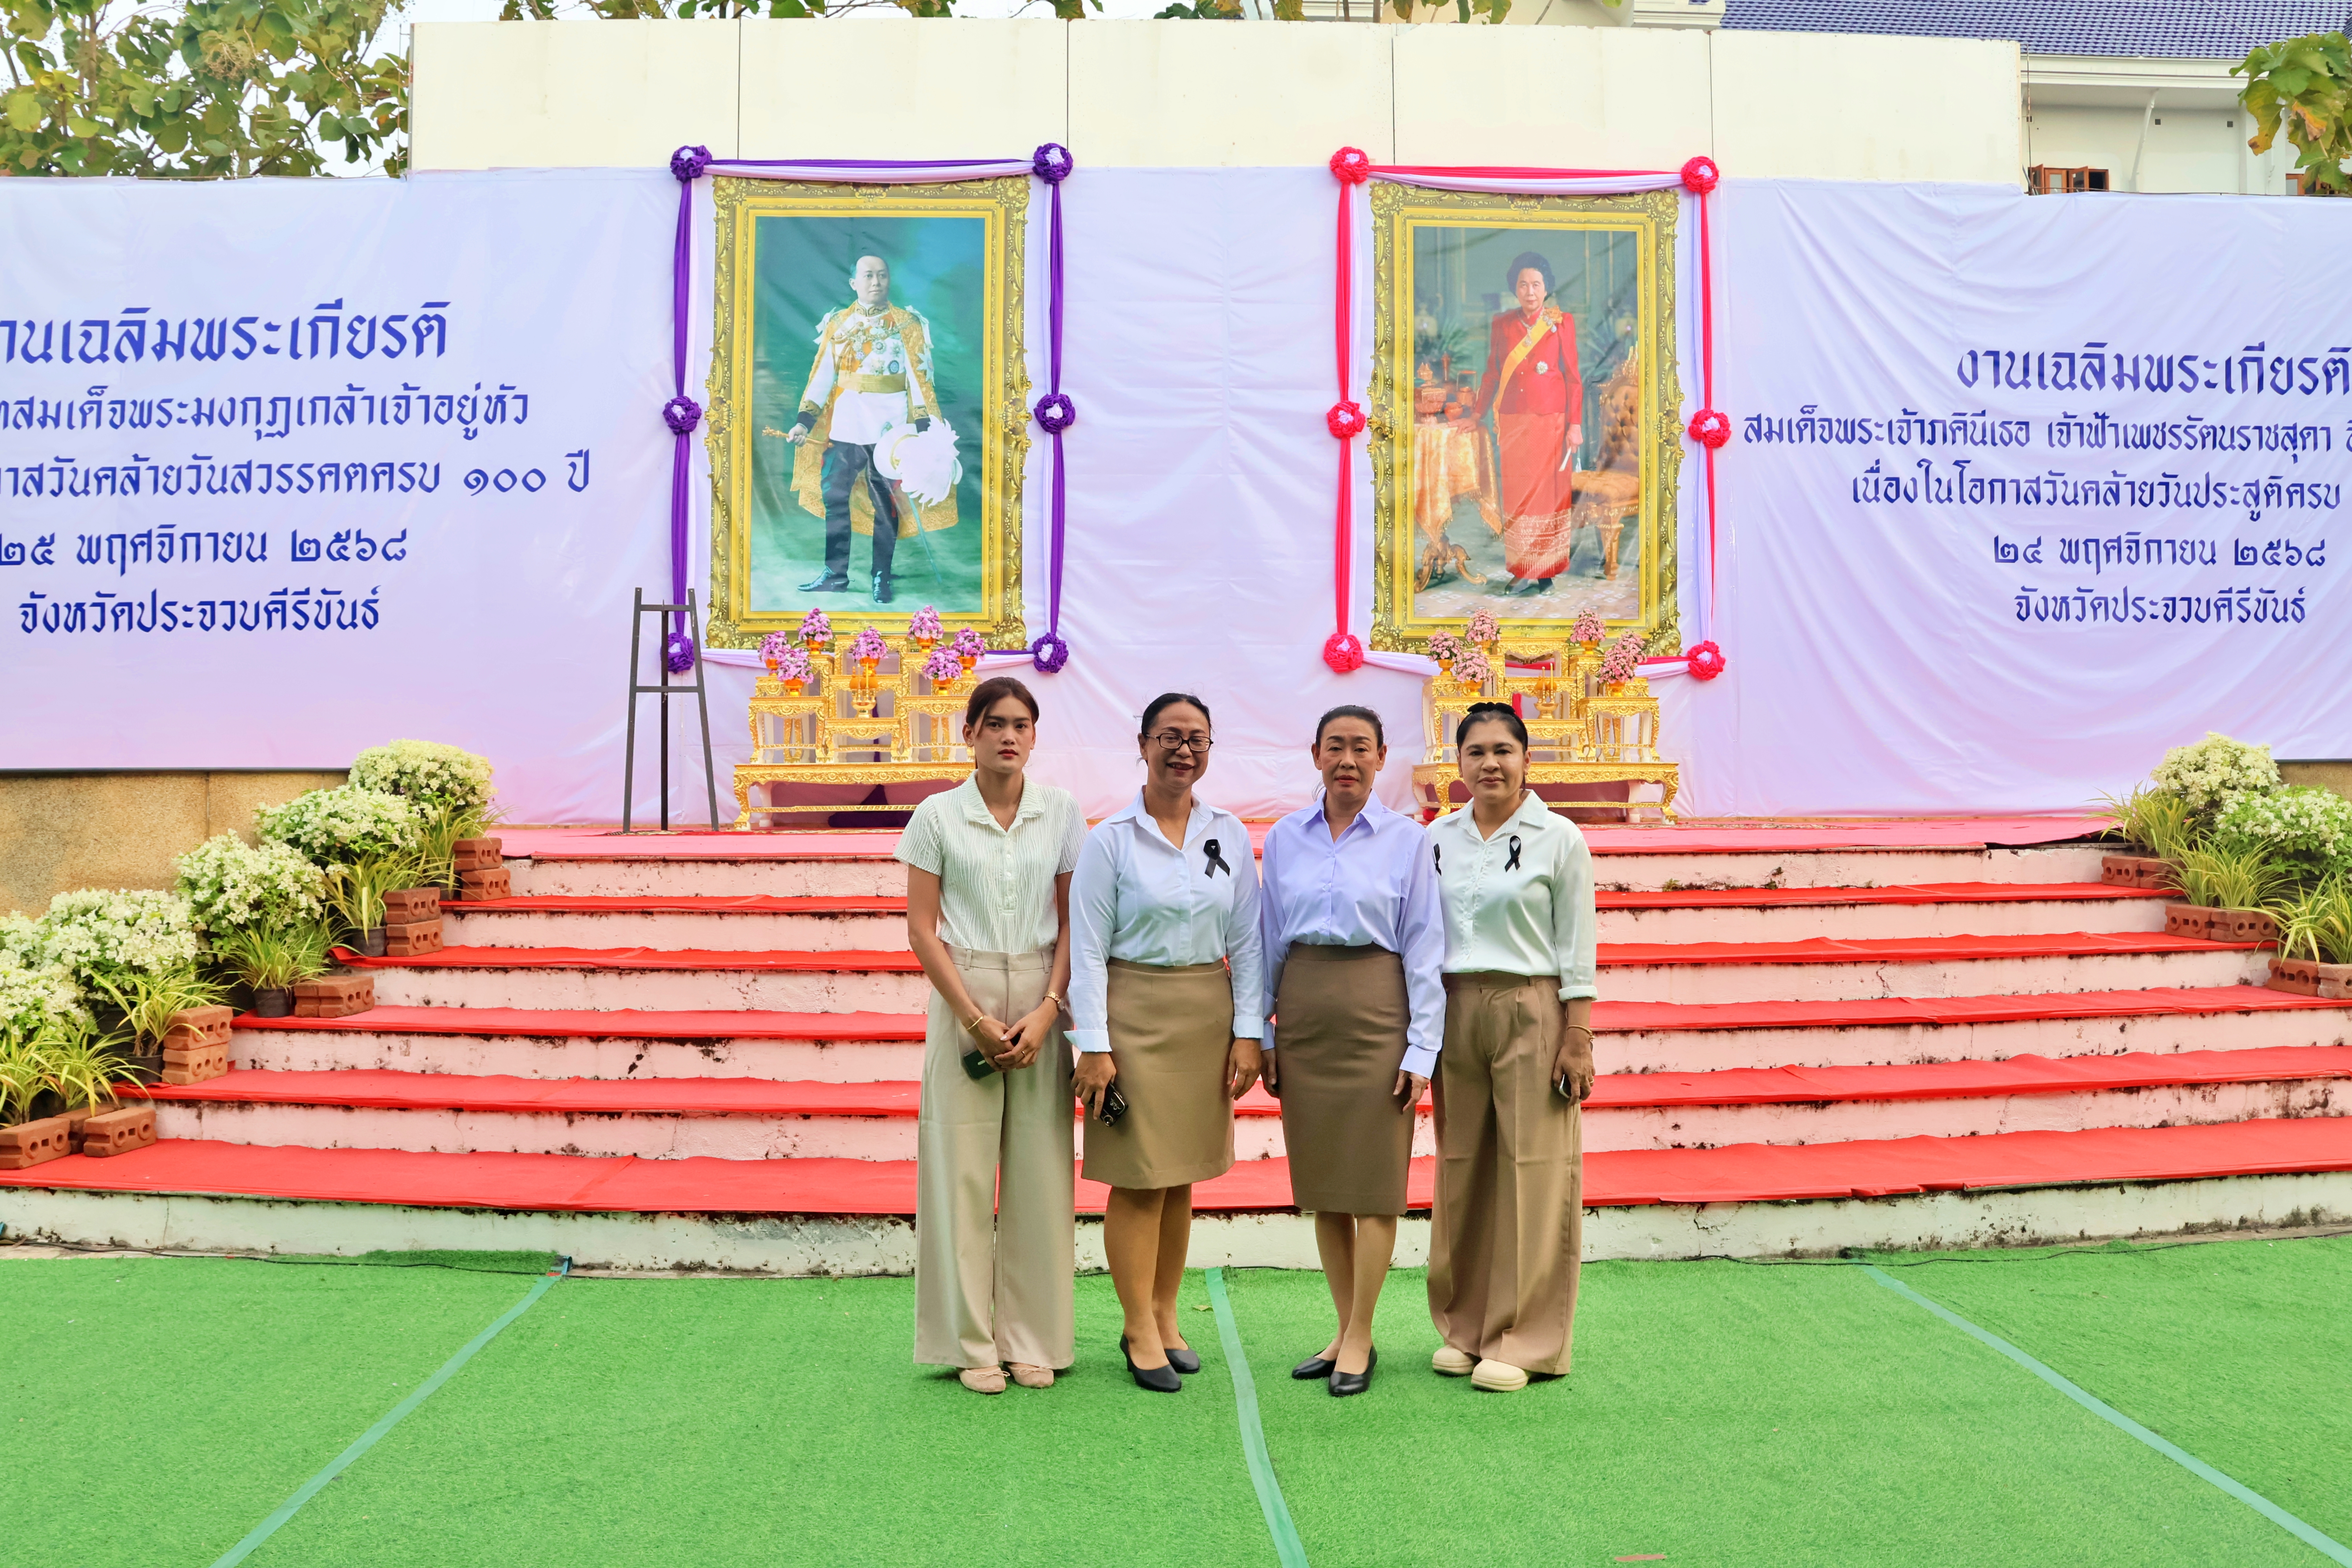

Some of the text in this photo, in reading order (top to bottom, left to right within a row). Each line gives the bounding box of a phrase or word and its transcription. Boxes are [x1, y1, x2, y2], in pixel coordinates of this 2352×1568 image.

[1957, 341, 2352, 396] งานเฉลิมพระเกียรติ
[1744, 405, 2030, 447] สมเด็จพระเจ้าภคินีเธอ
[2048, 411, 2331, 464] เจ้าฟ้าเพชรรัตนราชสุดา
[0, 449, 589, 497] าสวันคล้ายวันสวรรคตครบ ๑๐๐ ปี
[1853, 458, 2340, 522] เนื่องในโอกาสวันคล้ายวันประสูติครบ
[76, 524, 267, 577] พฤศจิกายน
[291, 528, 407, 562] ๒๕๖๘
[1994, 532, 2325, 575] ๒๔ พฤศจิกายน ๒๕๖๘
[18, 585, 380, 634] จังหวัดประจวบคีรีขันธ์
[2014, 586, 2305, 623] จังหวัดประจวบคีรีขันธ์
